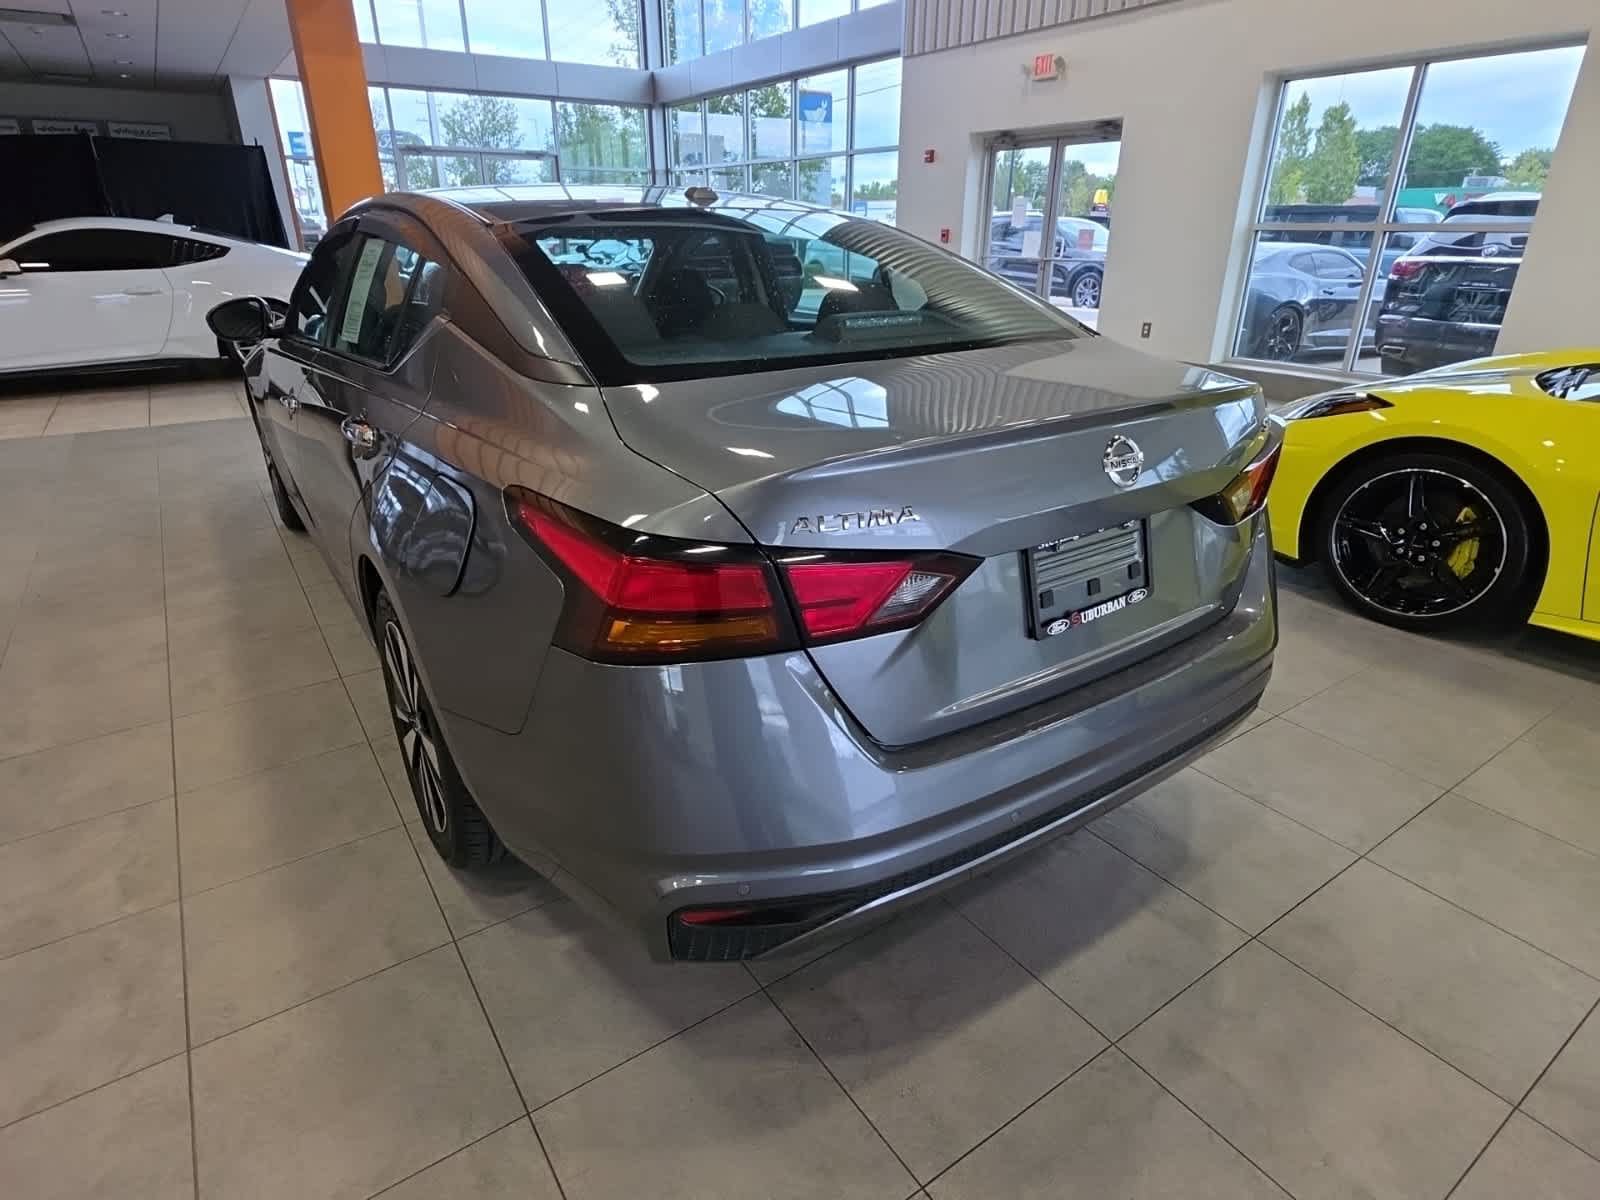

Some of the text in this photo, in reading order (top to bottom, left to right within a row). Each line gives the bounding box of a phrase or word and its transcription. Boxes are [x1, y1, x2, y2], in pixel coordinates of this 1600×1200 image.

[1034, 54, 1054, 76] EXIT
[790, 505, 921, 536] ALTIMA
[1071, 595, 1126, 626] SUBURBAN
